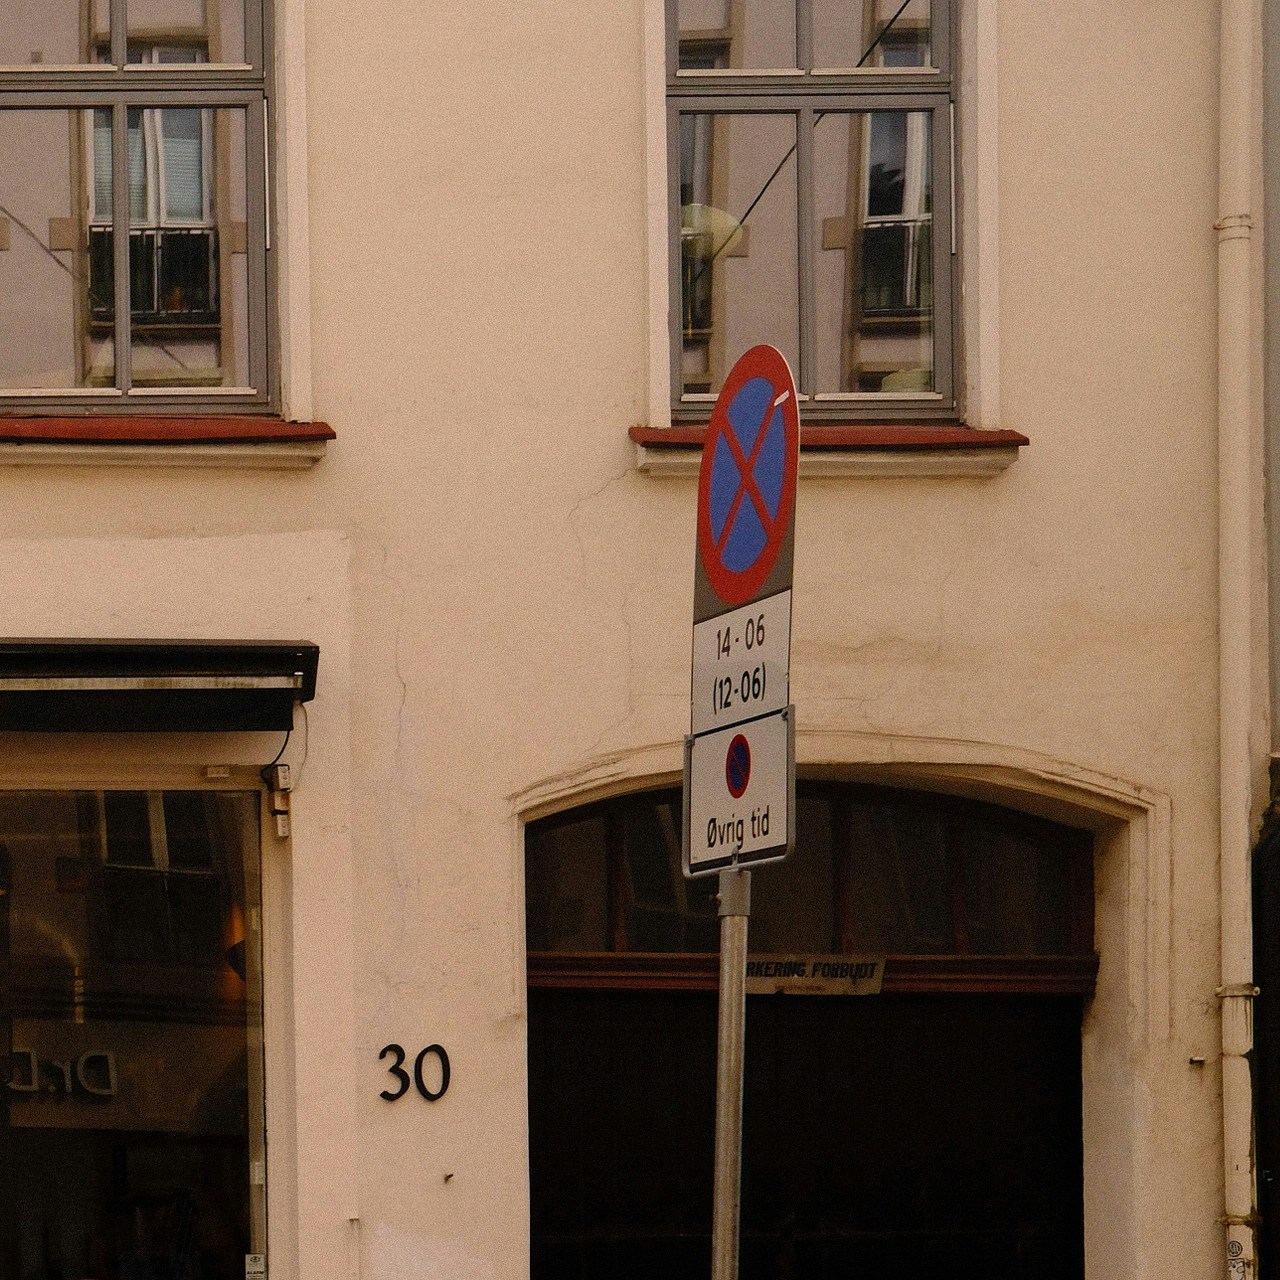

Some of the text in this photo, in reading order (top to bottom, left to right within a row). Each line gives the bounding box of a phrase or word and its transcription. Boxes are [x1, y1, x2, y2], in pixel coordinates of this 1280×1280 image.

[707, 805, 769, 850] Øvrig tid
[811, 962, 878, 979] FORBUDT
[379, 1044, 450, 1101] 30
